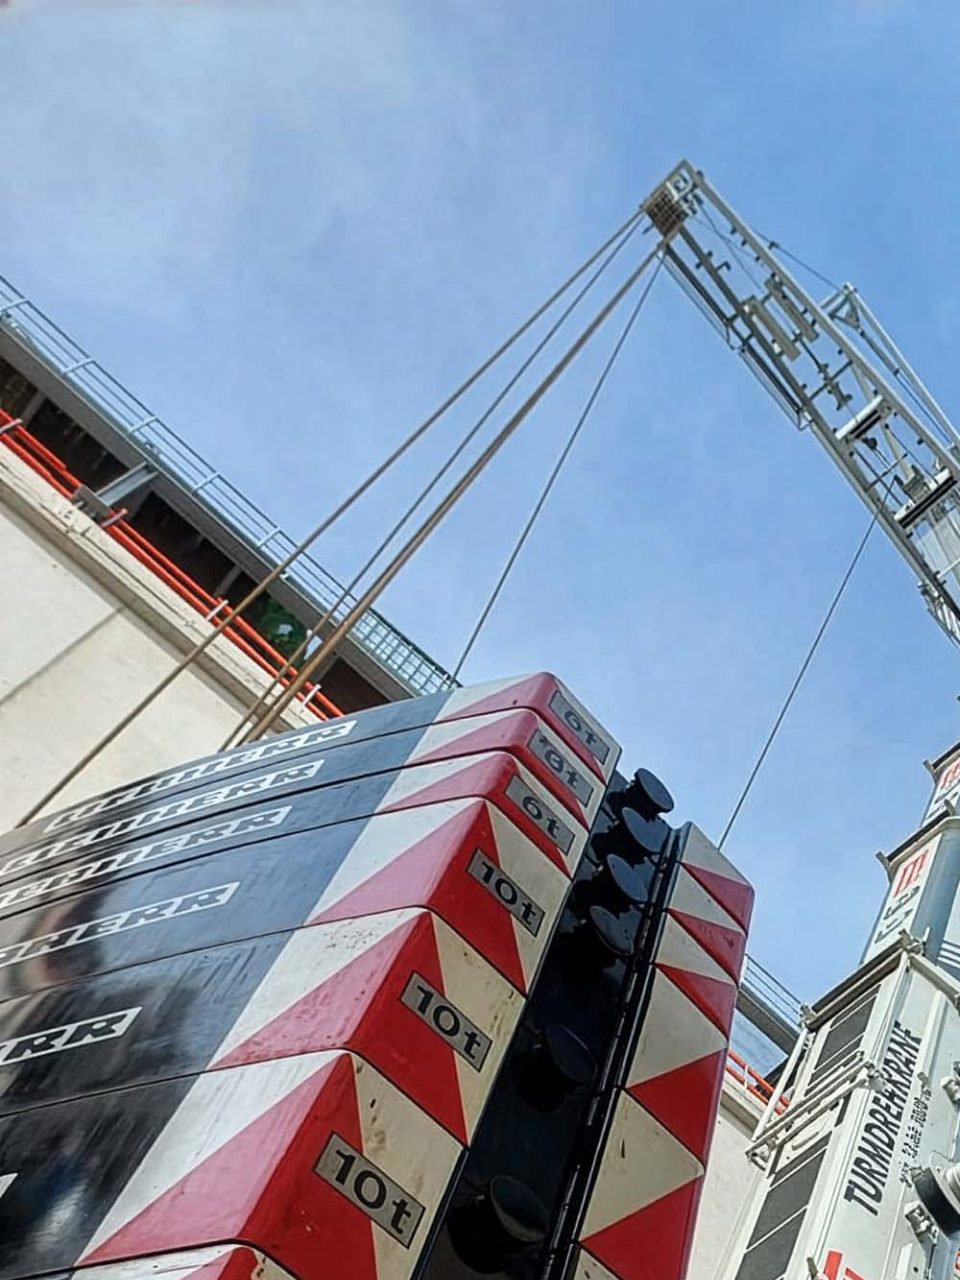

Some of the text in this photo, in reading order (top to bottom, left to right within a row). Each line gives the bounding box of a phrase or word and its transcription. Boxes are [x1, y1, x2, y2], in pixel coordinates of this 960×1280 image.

[522, 795, 560, 839] 6t
[479, 860, 538, 928] 10t
[0, 1008, 140, 1065] RR
[416, 983, 482, 1062] 10t
[336, 1149, 412, 1236] 10t
